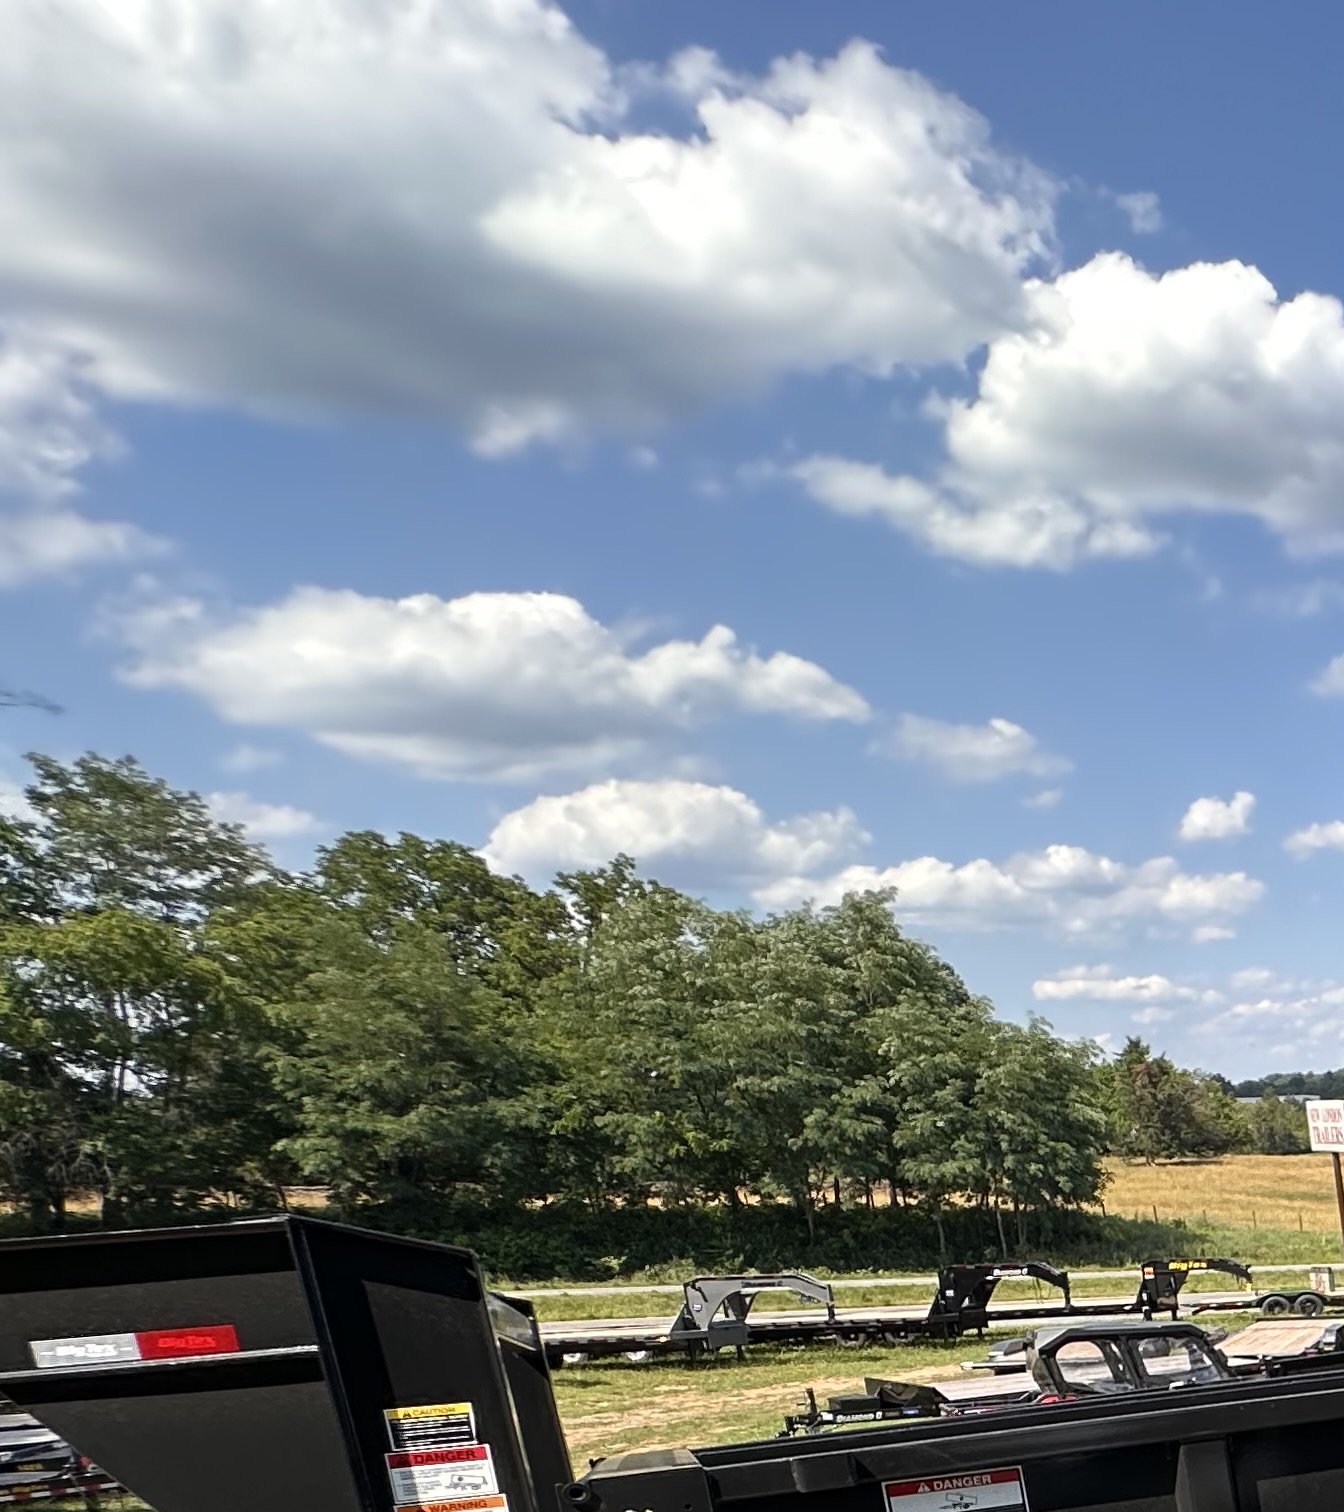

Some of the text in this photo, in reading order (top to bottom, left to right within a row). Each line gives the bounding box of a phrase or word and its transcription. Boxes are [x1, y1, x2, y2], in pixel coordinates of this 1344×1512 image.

[1312, 1126, 1344, 1145] TRAILERS
[412, 1406, 456, 1416] CAUTION
[413, 1450, 477, 1465] DANGER
[932, 1474, 992, 1491] DANGER
[428, 1499, 488, 1512] WARNING
